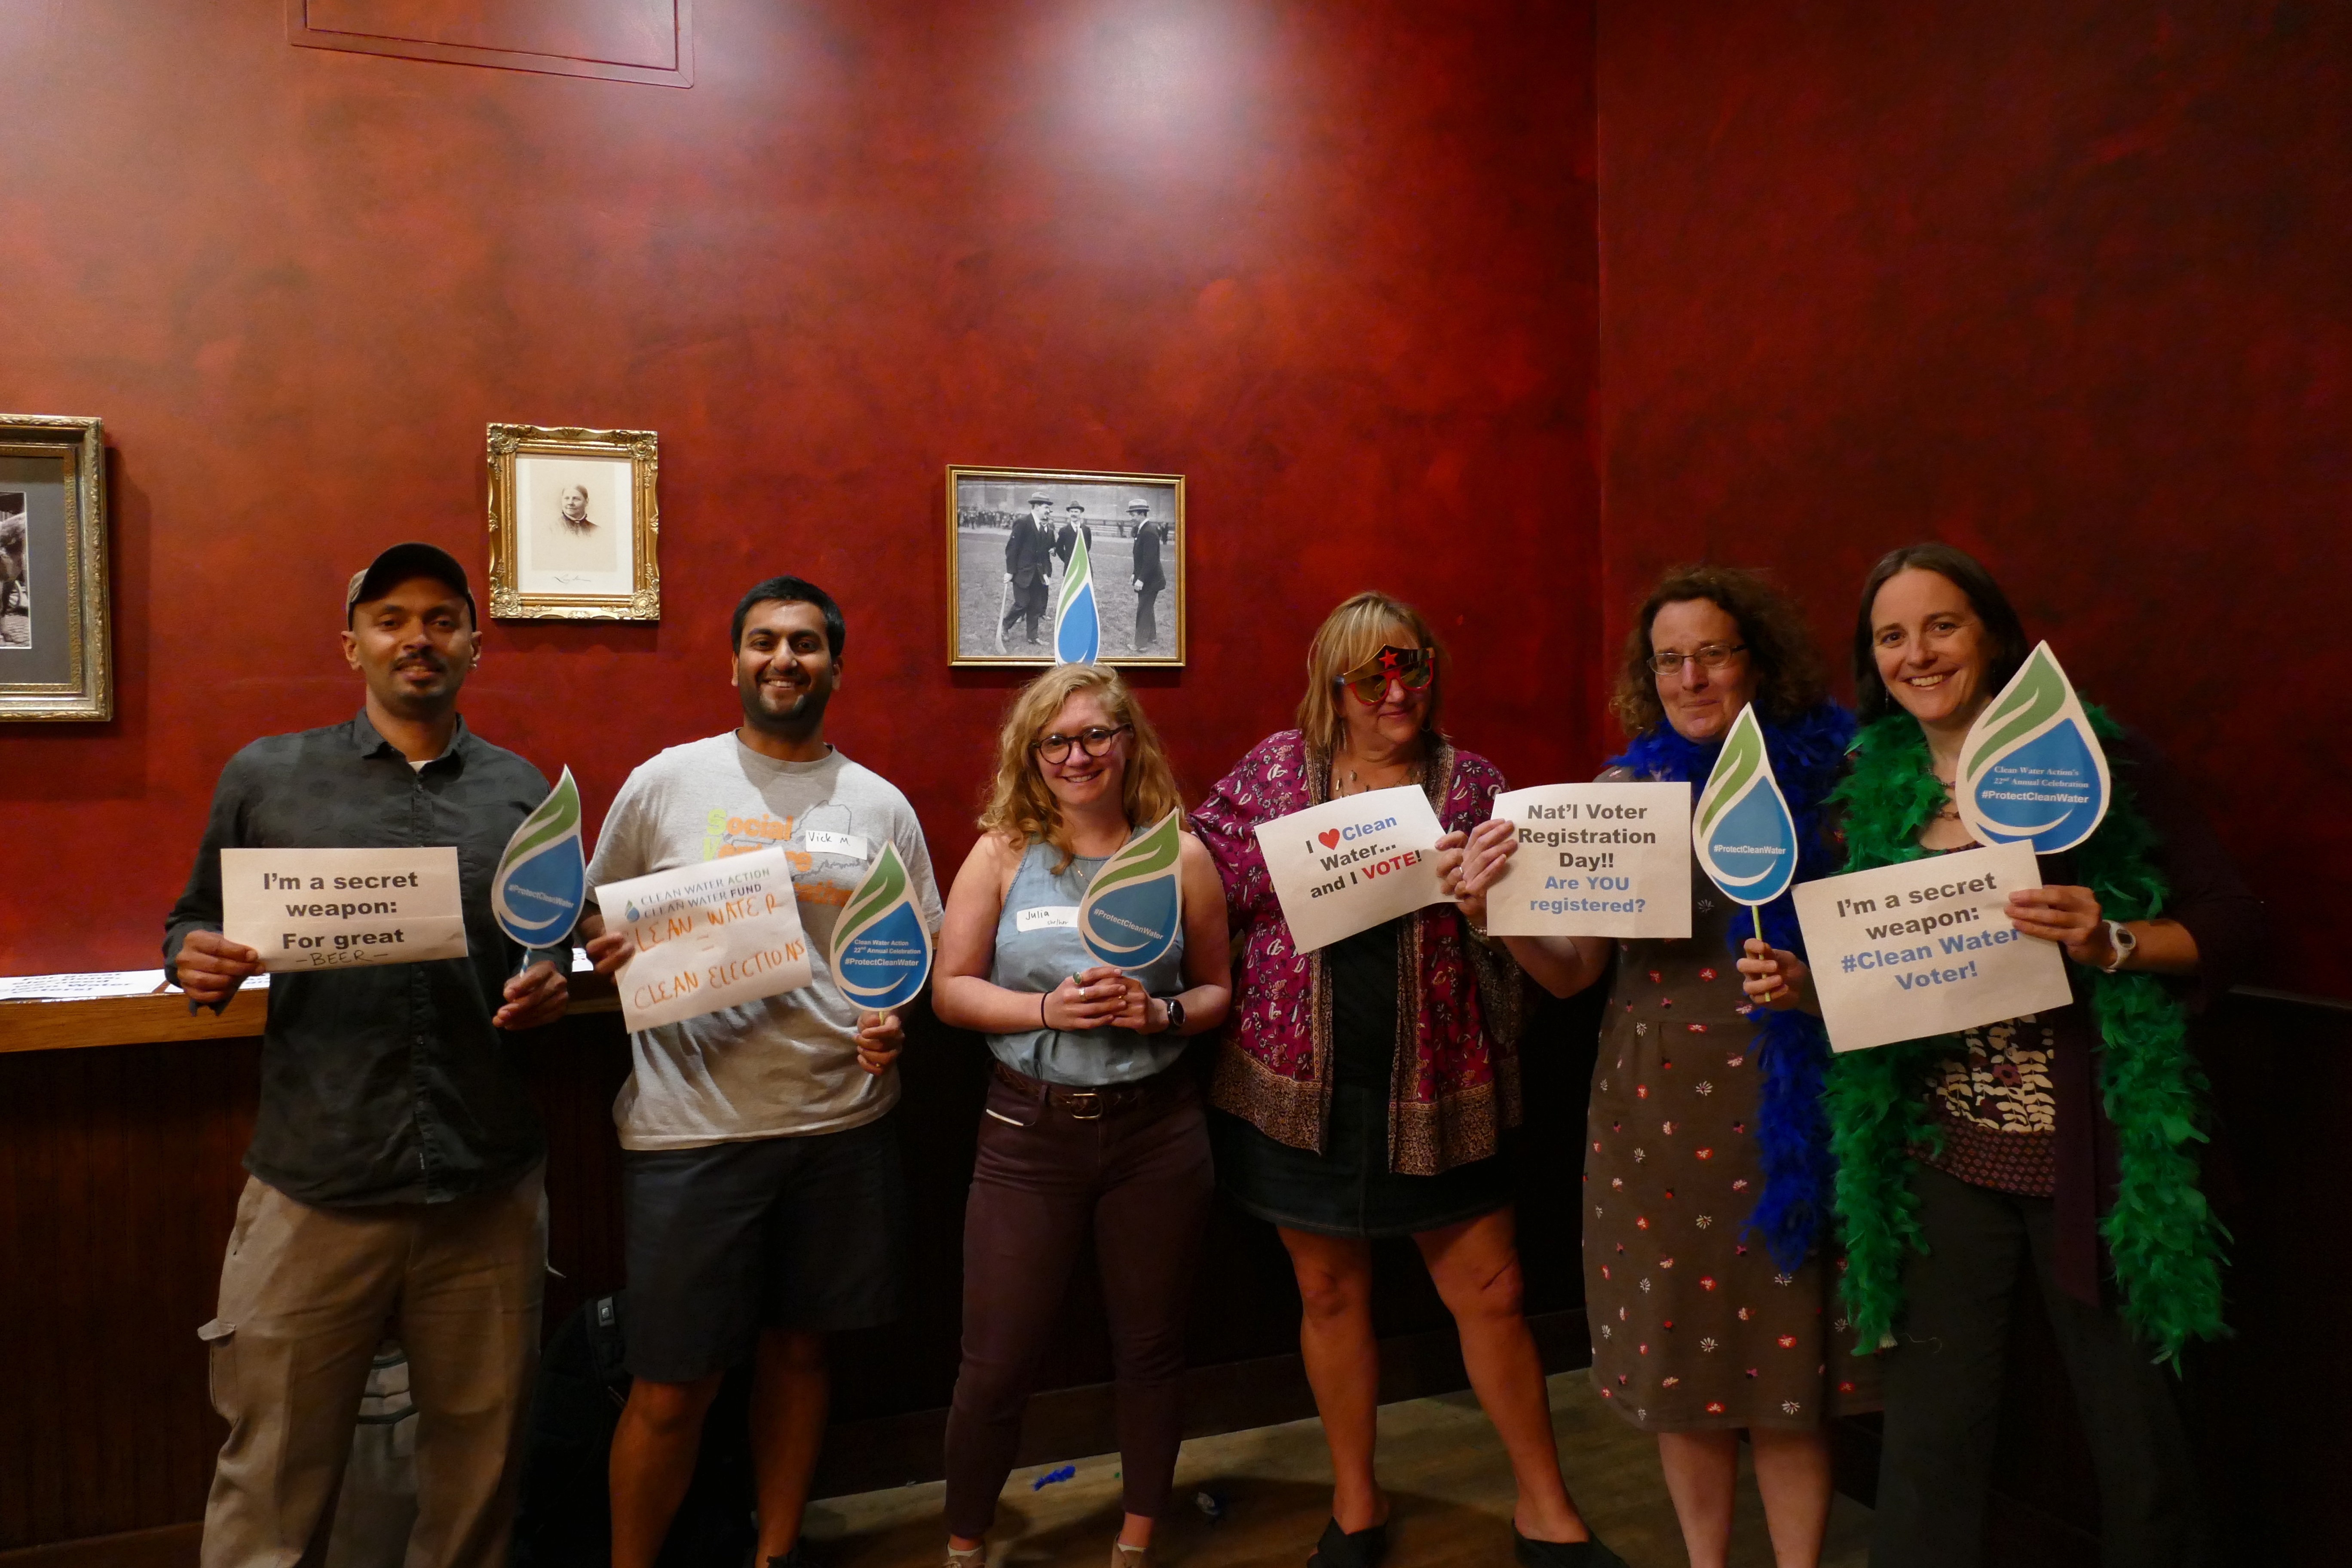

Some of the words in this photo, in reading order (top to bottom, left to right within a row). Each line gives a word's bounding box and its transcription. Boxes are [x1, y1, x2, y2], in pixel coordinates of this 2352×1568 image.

[2042, 779, 2089, 788] Celebration
[1981, 790, 2089, 803] #ProtectCleanWater
[706, 808, 793, 841] Social
[1586, 804, 1648, 820] Voter
[808, 832, 832, 842] Vick
[1305, 840, 1314, 854] I
[1341, 817, 1397, 841] Clean
[1518, 828, 1656, 847] Registration
[1320, 842, 1396, 872] Water...
[1559, 852, 1614, 871] Day!!
[1714, 845, 1786, 854] #ProtectCleanWater
[263, 873, 300, 890] I'm
[310, 877, 324, 890] a
[334, 872, 419, 889] secret
[1310, 876, 1346, 898] and
[1350, 872, 1358, 885] I
[1361, 849, 1422, 880] VOTE!
[1544, 876, 1579, 890] Are
[1585, 876, 1629, 891] YOU
[641, 888, 681, 905] CLEAN
[684, 879, 723, 894] WATER
[728, 868, 770, 885] ACTION
[1836, 898, 1876, 918] I'm
[1885, 894, 1901, 909] a
[1908, 872, 1997, 903] secret
[286, 901, 398, 919] weapon:
[644, 901, 685, 918] CLEAN
[688, 891, 727, 908] WATER
[730, 884, 762, 898] FUND
[1530, 897, 1646, 914] registered?
[627, 915, 692, 952] LEAN
[707, 892, 784, 925] WATER
[1026, 910, 1049, 920] Julia
[1093, 907, 1164, 940] #ProtectCleanWater
[1865, 906, 1980, 940] weapon:
[282, 933, 325, 949] For
[334, 928, 404, 949] great
[1841, 944, 1932, 973] #Clean
[634, 971, 698, 1010] CLEAN
[708, 938, 806, 989] ELECTIONS
[1894, 961, 1978, 990] Voter!
